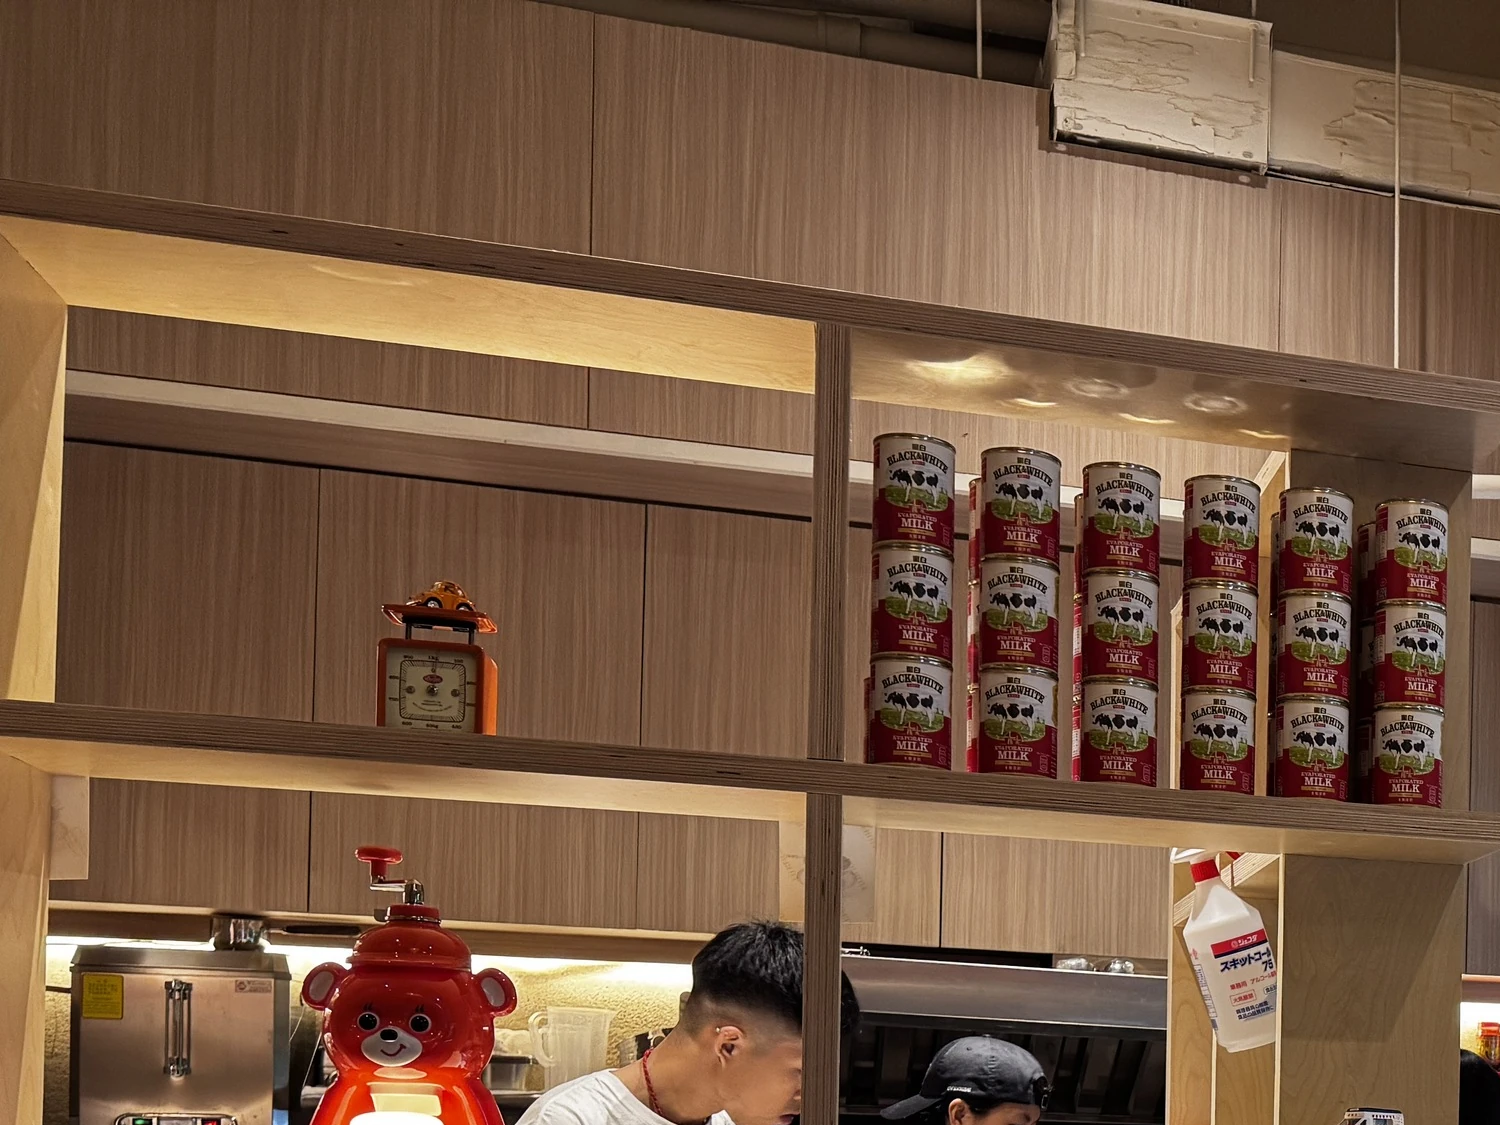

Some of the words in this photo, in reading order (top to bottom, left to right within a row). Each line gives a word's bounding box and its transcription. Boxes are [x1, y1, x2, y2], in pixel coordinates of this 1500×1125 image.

[887, 451, 949, 475] BLACK&WHITE
[992, 464, 1053, 488] BLACK&WHITE
[1095, 479, 1154, 500] BLACK&WHITE
[1200, 491, 1255, 511] BLACK&WHITE
[1293, 502, 1349, 523] BLACK&WHITE
[901, 517, 933, 531] MILK
[1397, 515, 1447, 534] BLACK&WHITE
[1006, 530, 1038, 544] MILK
[1109, 544, 1140, 558] MILK
[1214, 556, 1243, 569] MILK
[887, 562, 949, 586] BLACK&WHITE
[1306, 566, 1335, 580] MILK
[987, 572, 1047, 595] BLACK&WHITE
[1410, 577, 1436, 590] MILK
[1095, 587, 1154, 608] BLACK&WHITE
[1196, 599, 1253, 620] BLACK&WHITE
[1294, 607, 1348, 628] BLACK&WHITE
[1395, 618, 1444, 638] BLACK&WHITE
[902, 629, 934, 643] MILK
[1000, 639, 1032, 653] MILK
[1109, 652, 1139, 666] MILK
[1210, 663, 1239, 676] MILK
[881, 672, 944, 694] BLACK&WHITE
[1307, 671, 1335, 684] MILK
[984, 682, 1044, 705] BLACK&WHITE
[1408, 681, 1434, 694] MILK
[1090, 694, 1148, 716] BLACK&WHITE
[1192, 703, 1248, 726] BLACK&WHITE
[1292, 712, 1345, 733] BLACK&WHITE
[1379, 719, 1434, 741] BLACK&WHITE
[896, 739, 929, 753] MILK
[997, 748, 1029, 763] MILK
[1102, 758, 1133, 773] MILK
[1203, 767, 1233, 782] MILK
[1304, 775, 1332, 789] MILK
[1391, 781, 1420, 795] MILK
[1261, 959, 1274, 972] 75
